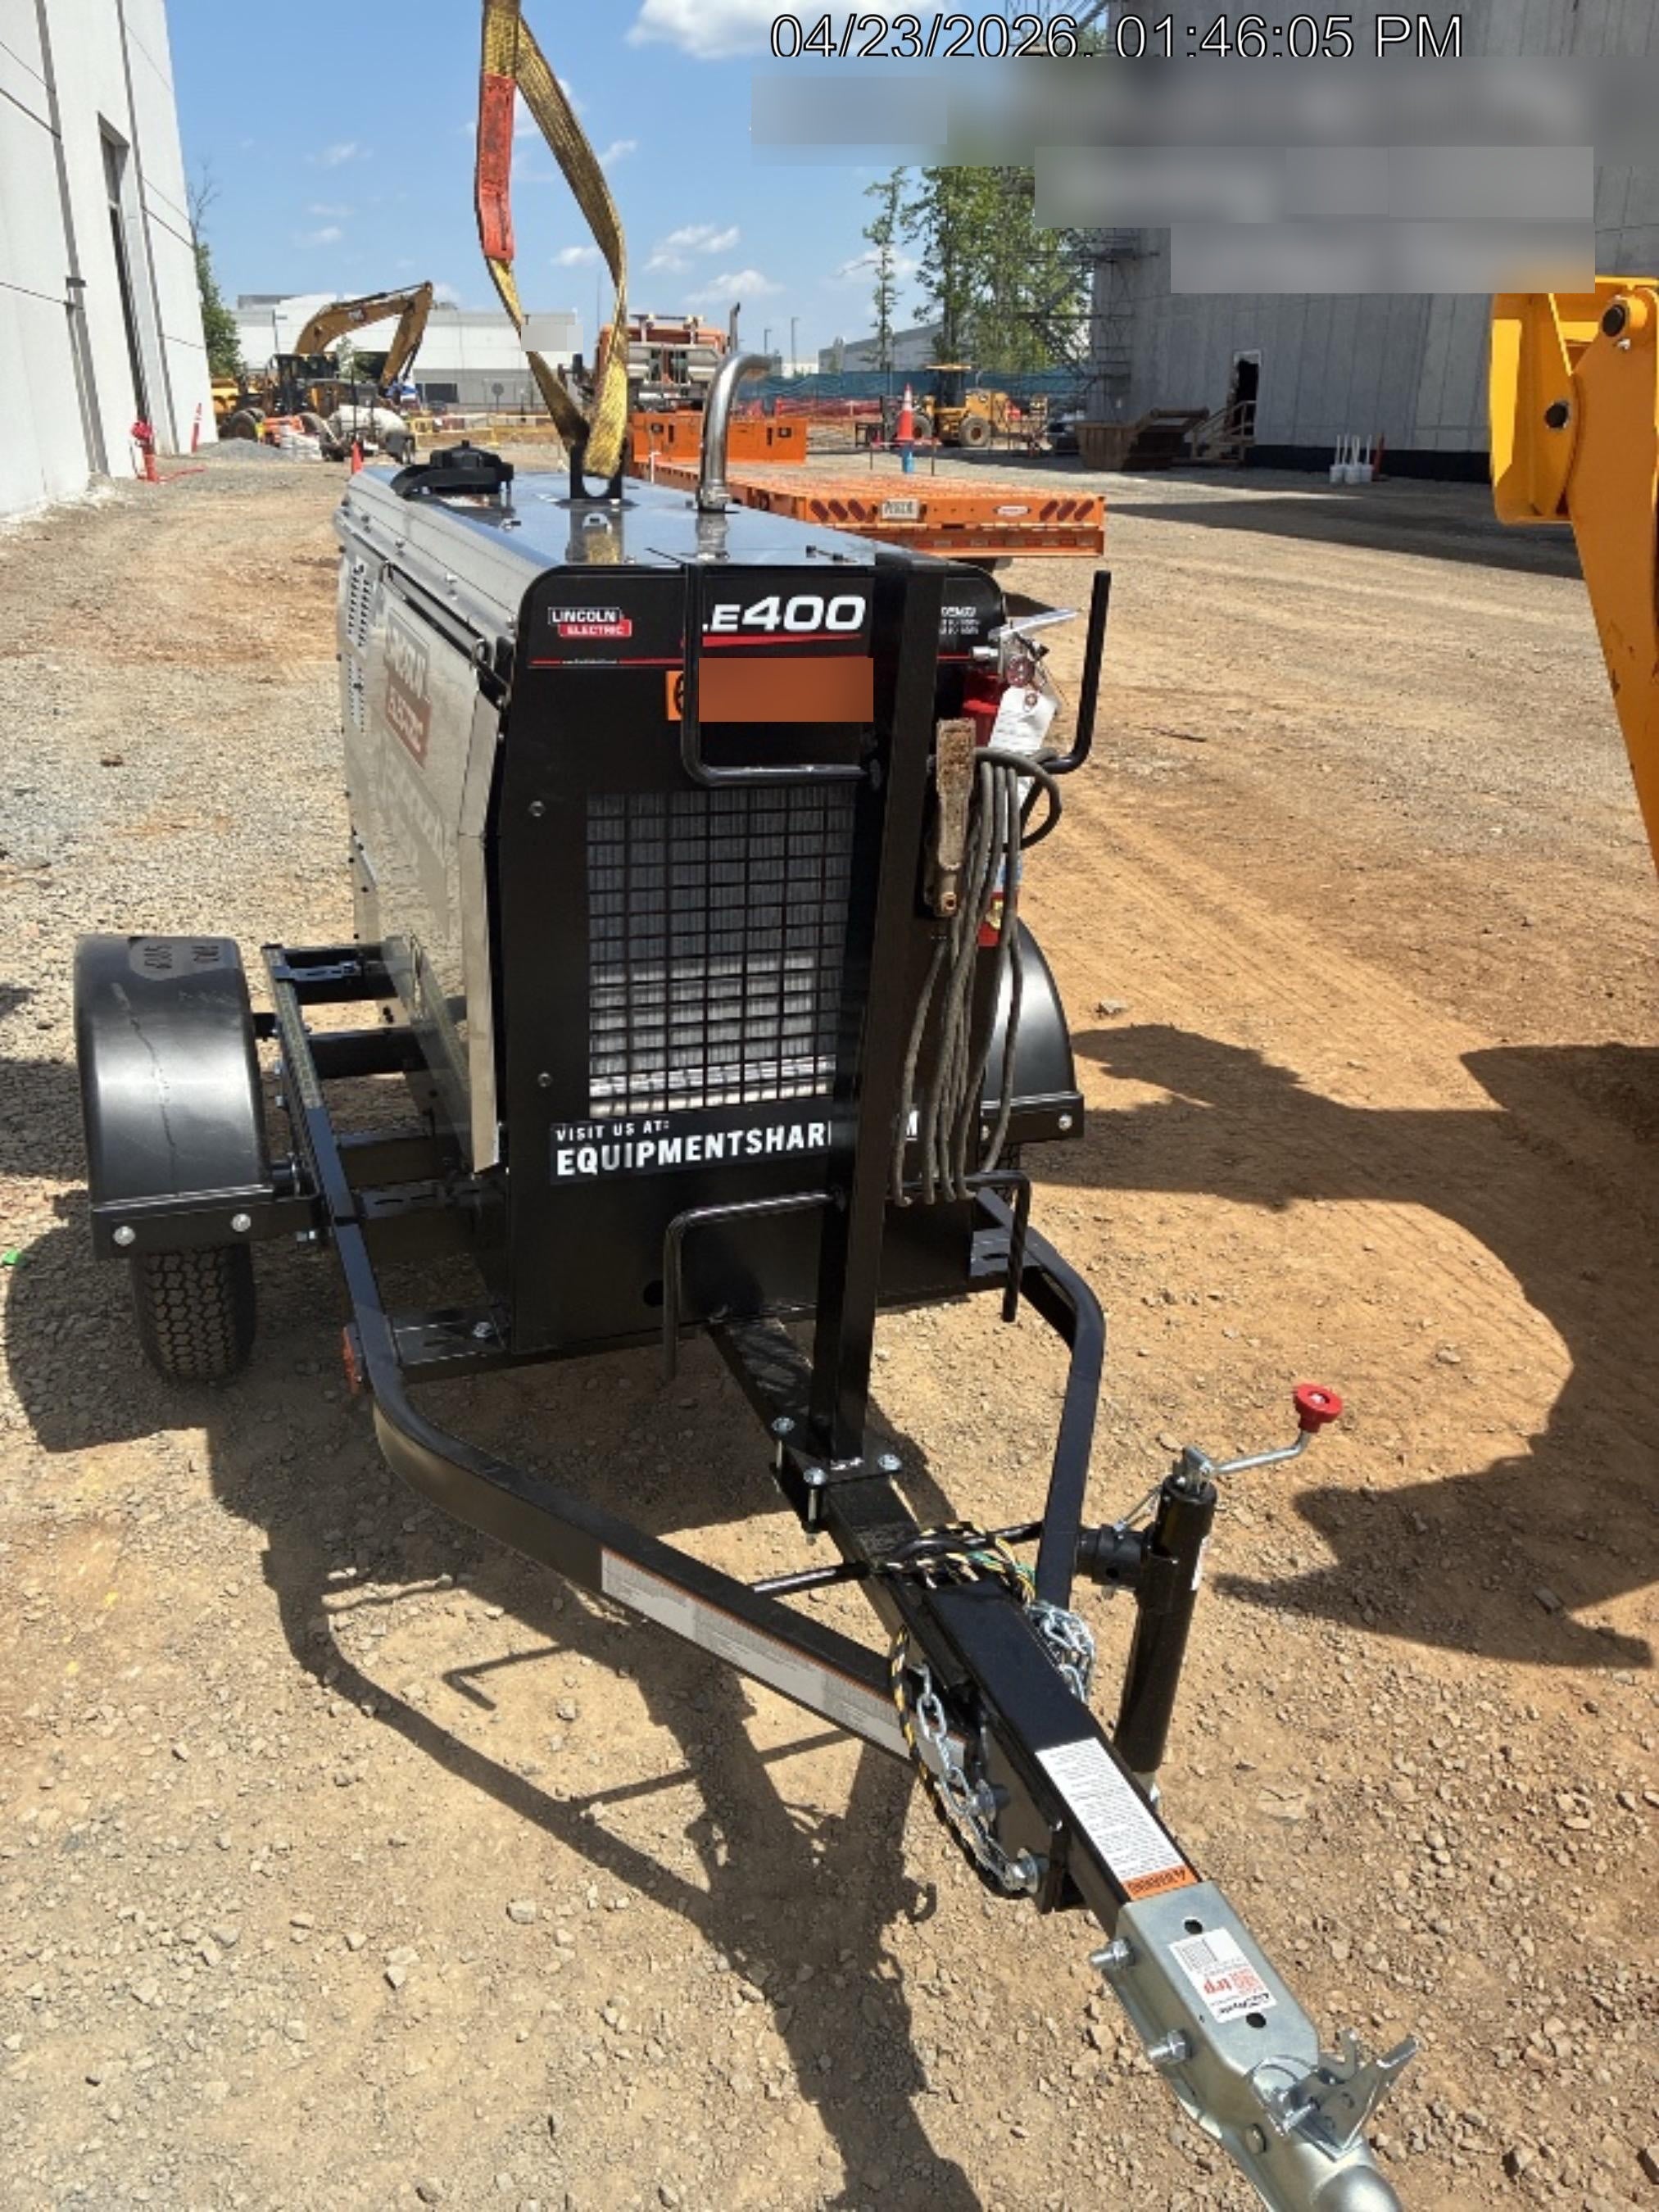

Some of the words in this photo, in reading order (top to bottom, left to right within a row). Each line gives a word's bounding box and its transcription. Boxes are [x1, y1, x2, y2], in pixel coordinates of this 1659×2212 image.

[552, 610, 616, 623] LINCOLN
[702, 595, 867, 632] E400
[566, 625, 625, 636] ELECTRIC
[555, 1124, 605, 1141] VISIT
[614, 1122, 635, 1136] US
[643, 1120, 669, 1134] AT:
[556, 1121, 832, 1176] EQUIPMENTSHAR
